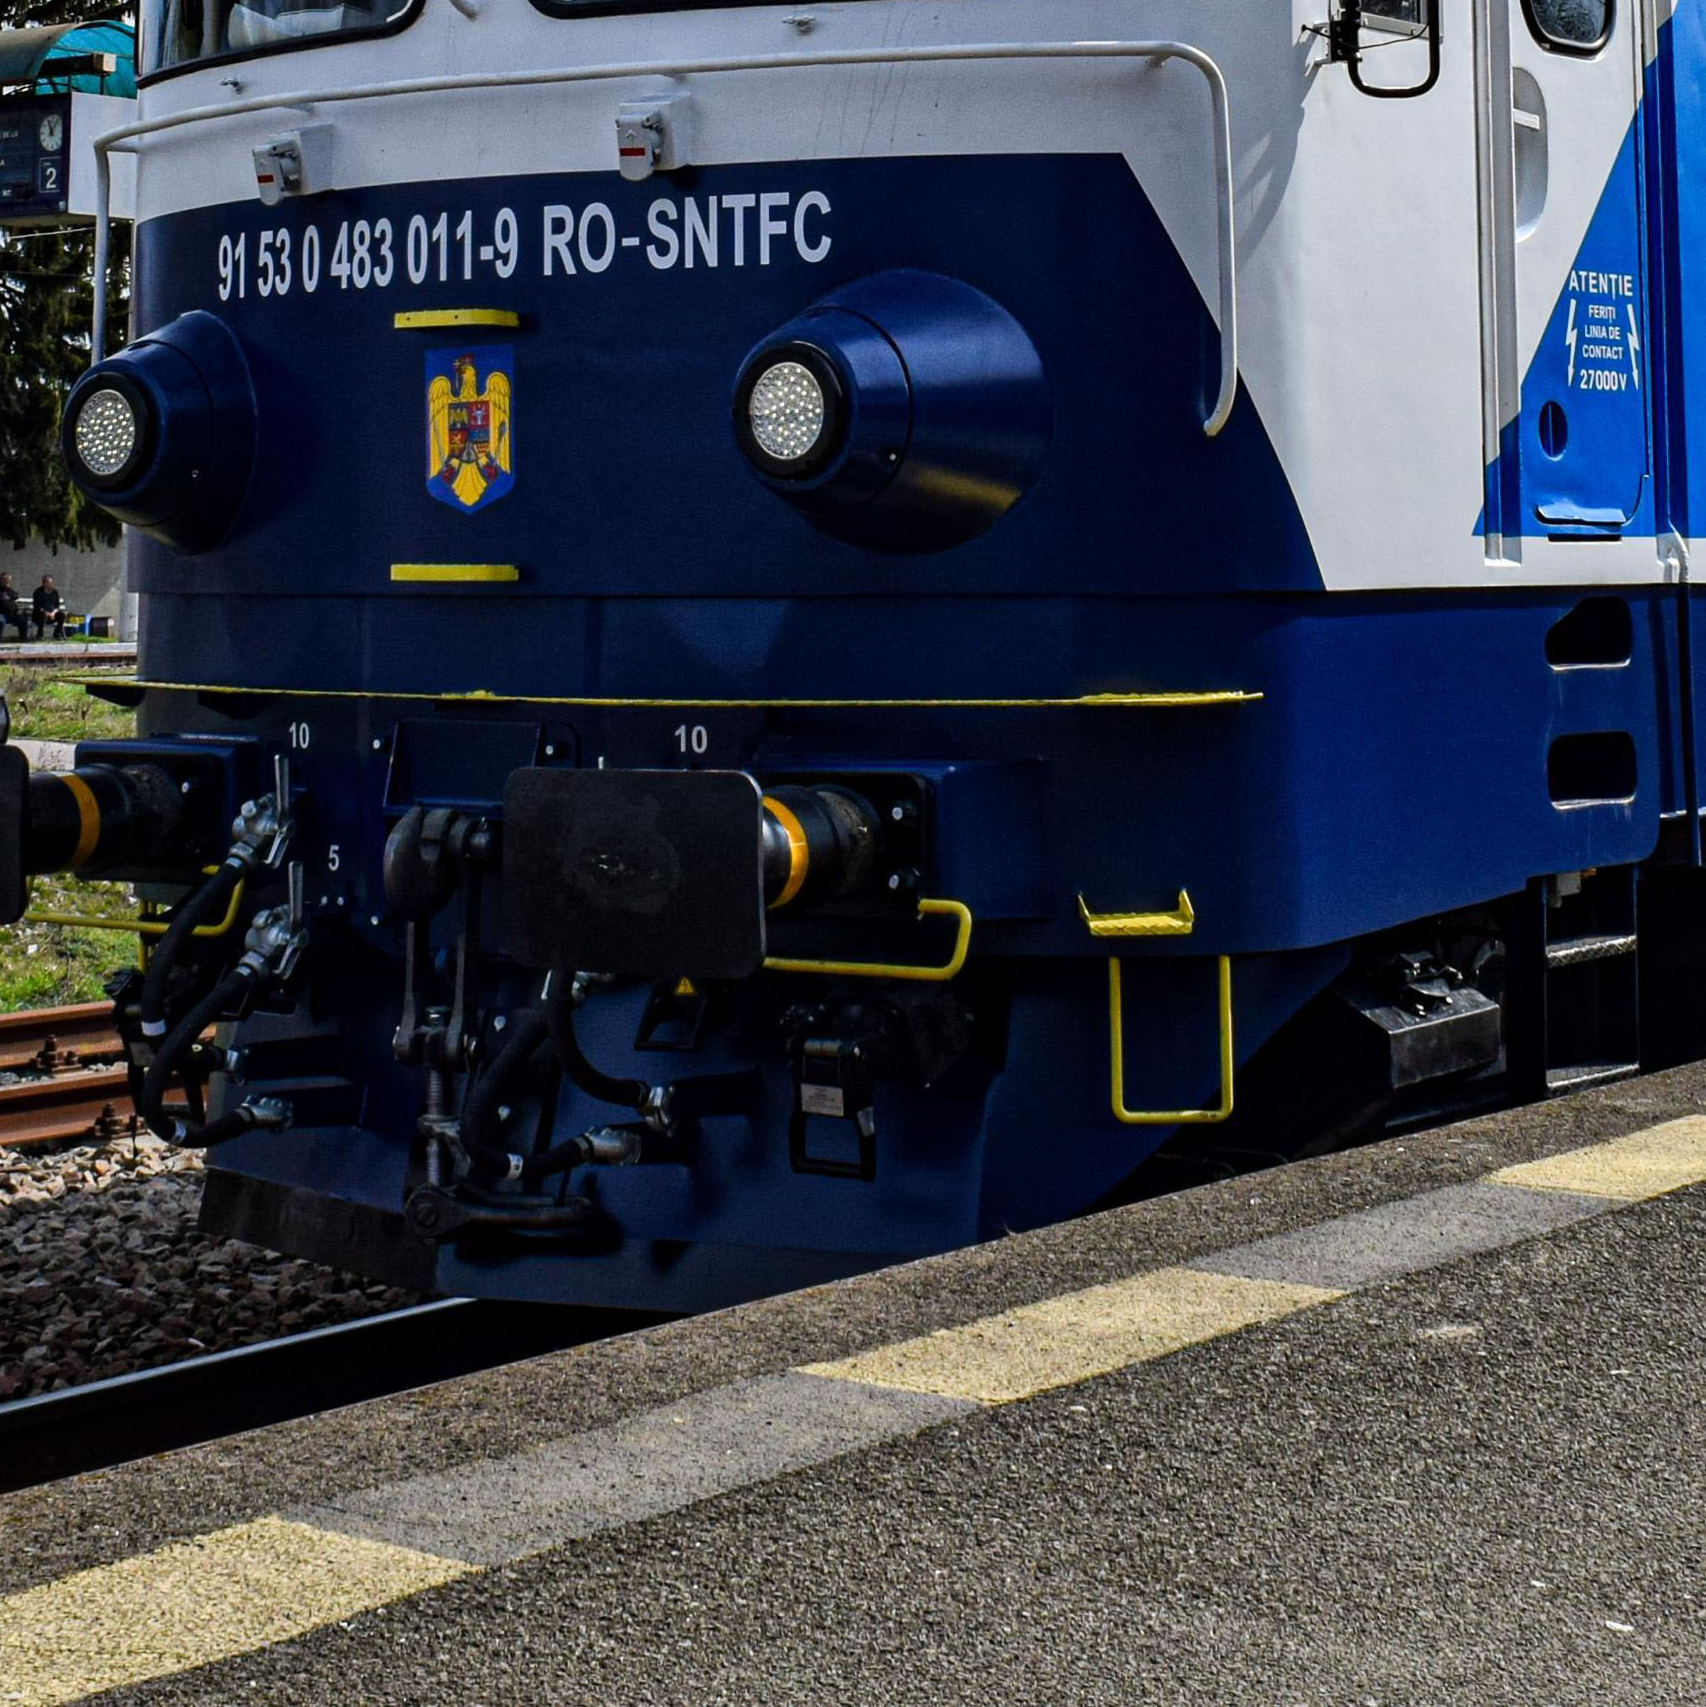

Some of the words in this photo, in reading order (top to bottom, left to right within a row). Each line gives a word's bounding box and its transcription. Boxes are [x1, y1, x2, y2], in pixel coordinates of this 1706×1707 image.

[45, 167, 57, 189] 2
[218, 232, 246, 302] 91
[257, 227, 292, 297] 53
[301, 224, 320, 293] 0
[330, 217, 393, 290] 483
[406, 207, 519, 285] 011-9
[543, 190, 832, 276] RO-SNTFC
[1568, 269, 1634, 300] ATENȚIE
[1584, 324, 1608, 339] LINIA
[1608, 326, 1621, 340] DE
[1582, 344, 1624, 360] CONTACT
[288, 721, 310, 749] 10
[674, 724, 709, 754] 10
[328, 845, 340, 872] 5
